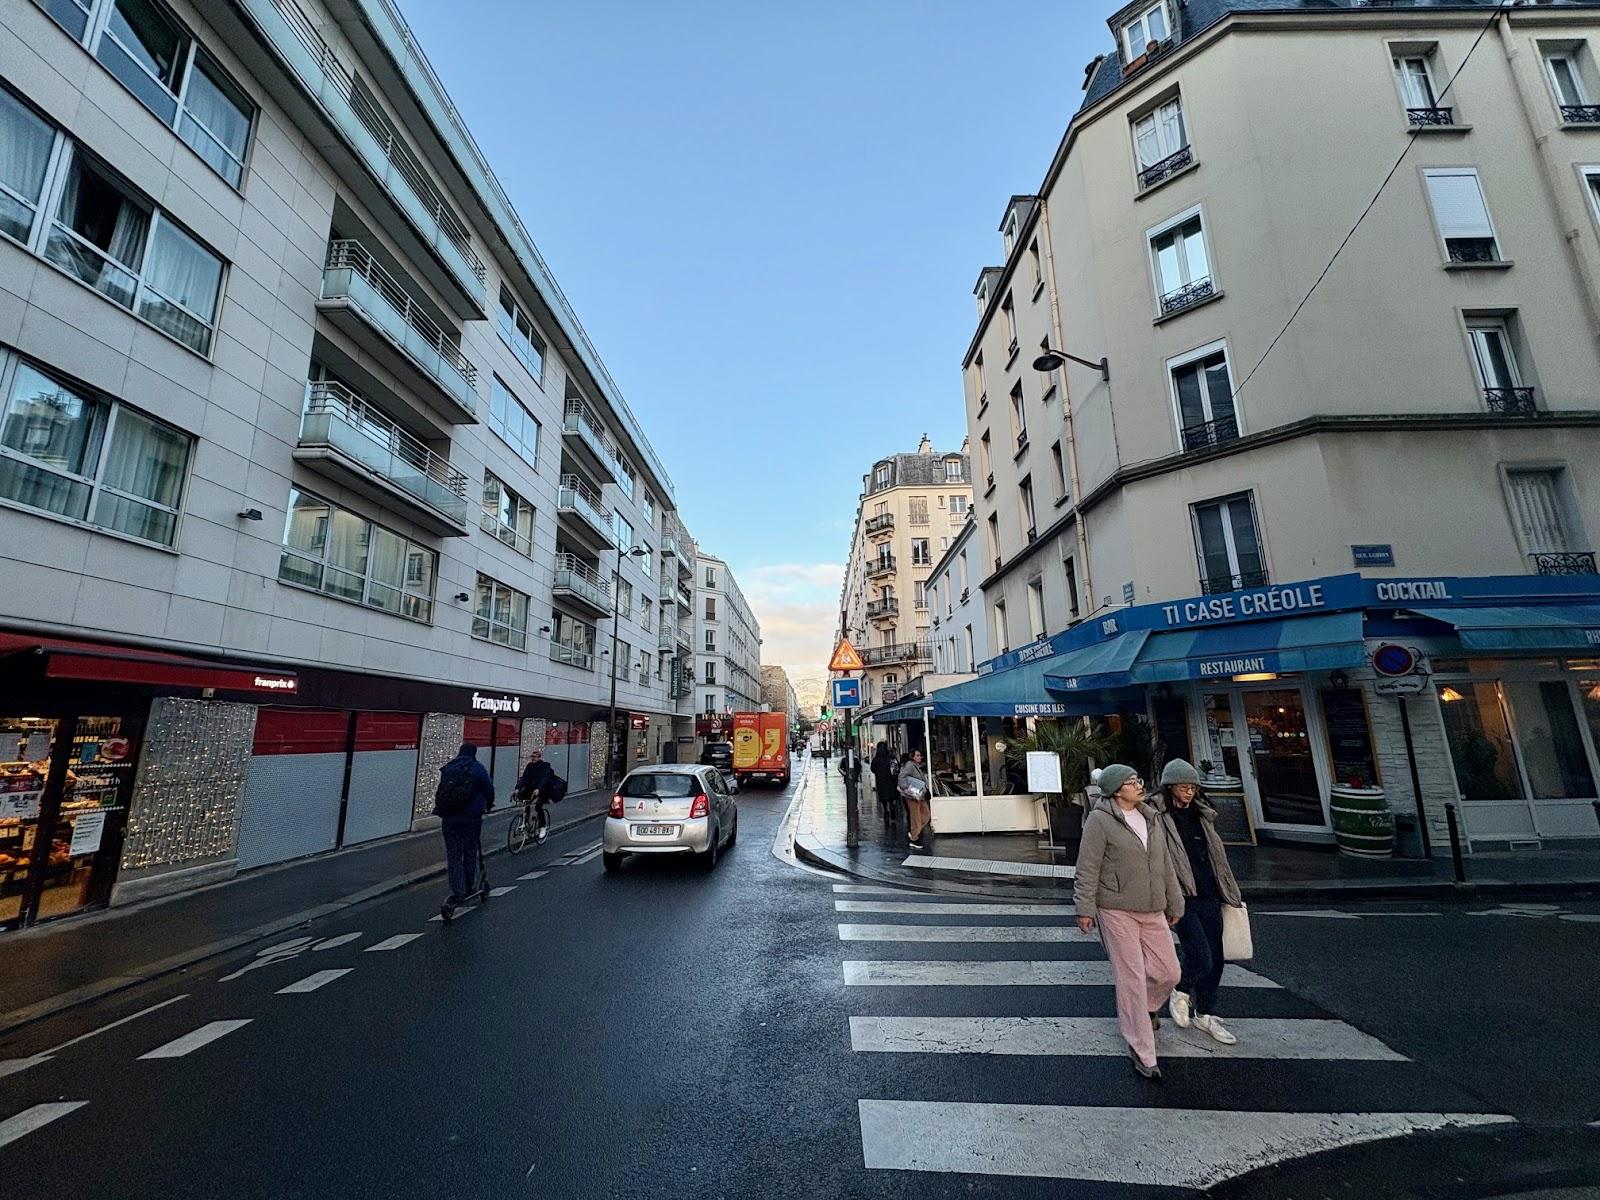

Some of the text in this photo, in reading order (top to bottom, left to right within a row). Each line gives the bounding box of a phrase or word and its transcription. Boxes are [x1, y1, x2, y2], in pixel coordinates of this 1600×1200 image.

[1376, 581, 1453, 600] COCKTAIL
[1162, 585, 1325, 625] TI CASE CRÉOLE
[1102, 618, 1119, 635] BAR
[1200, 657, 1265, 676] RESTAURANT
[255, 676, 288, 689] franprix
[472, 692, 512, 713] franprix
[1014, 703, 1039, 714] CUISINE
[1039, 703, 1051, 713] DES
